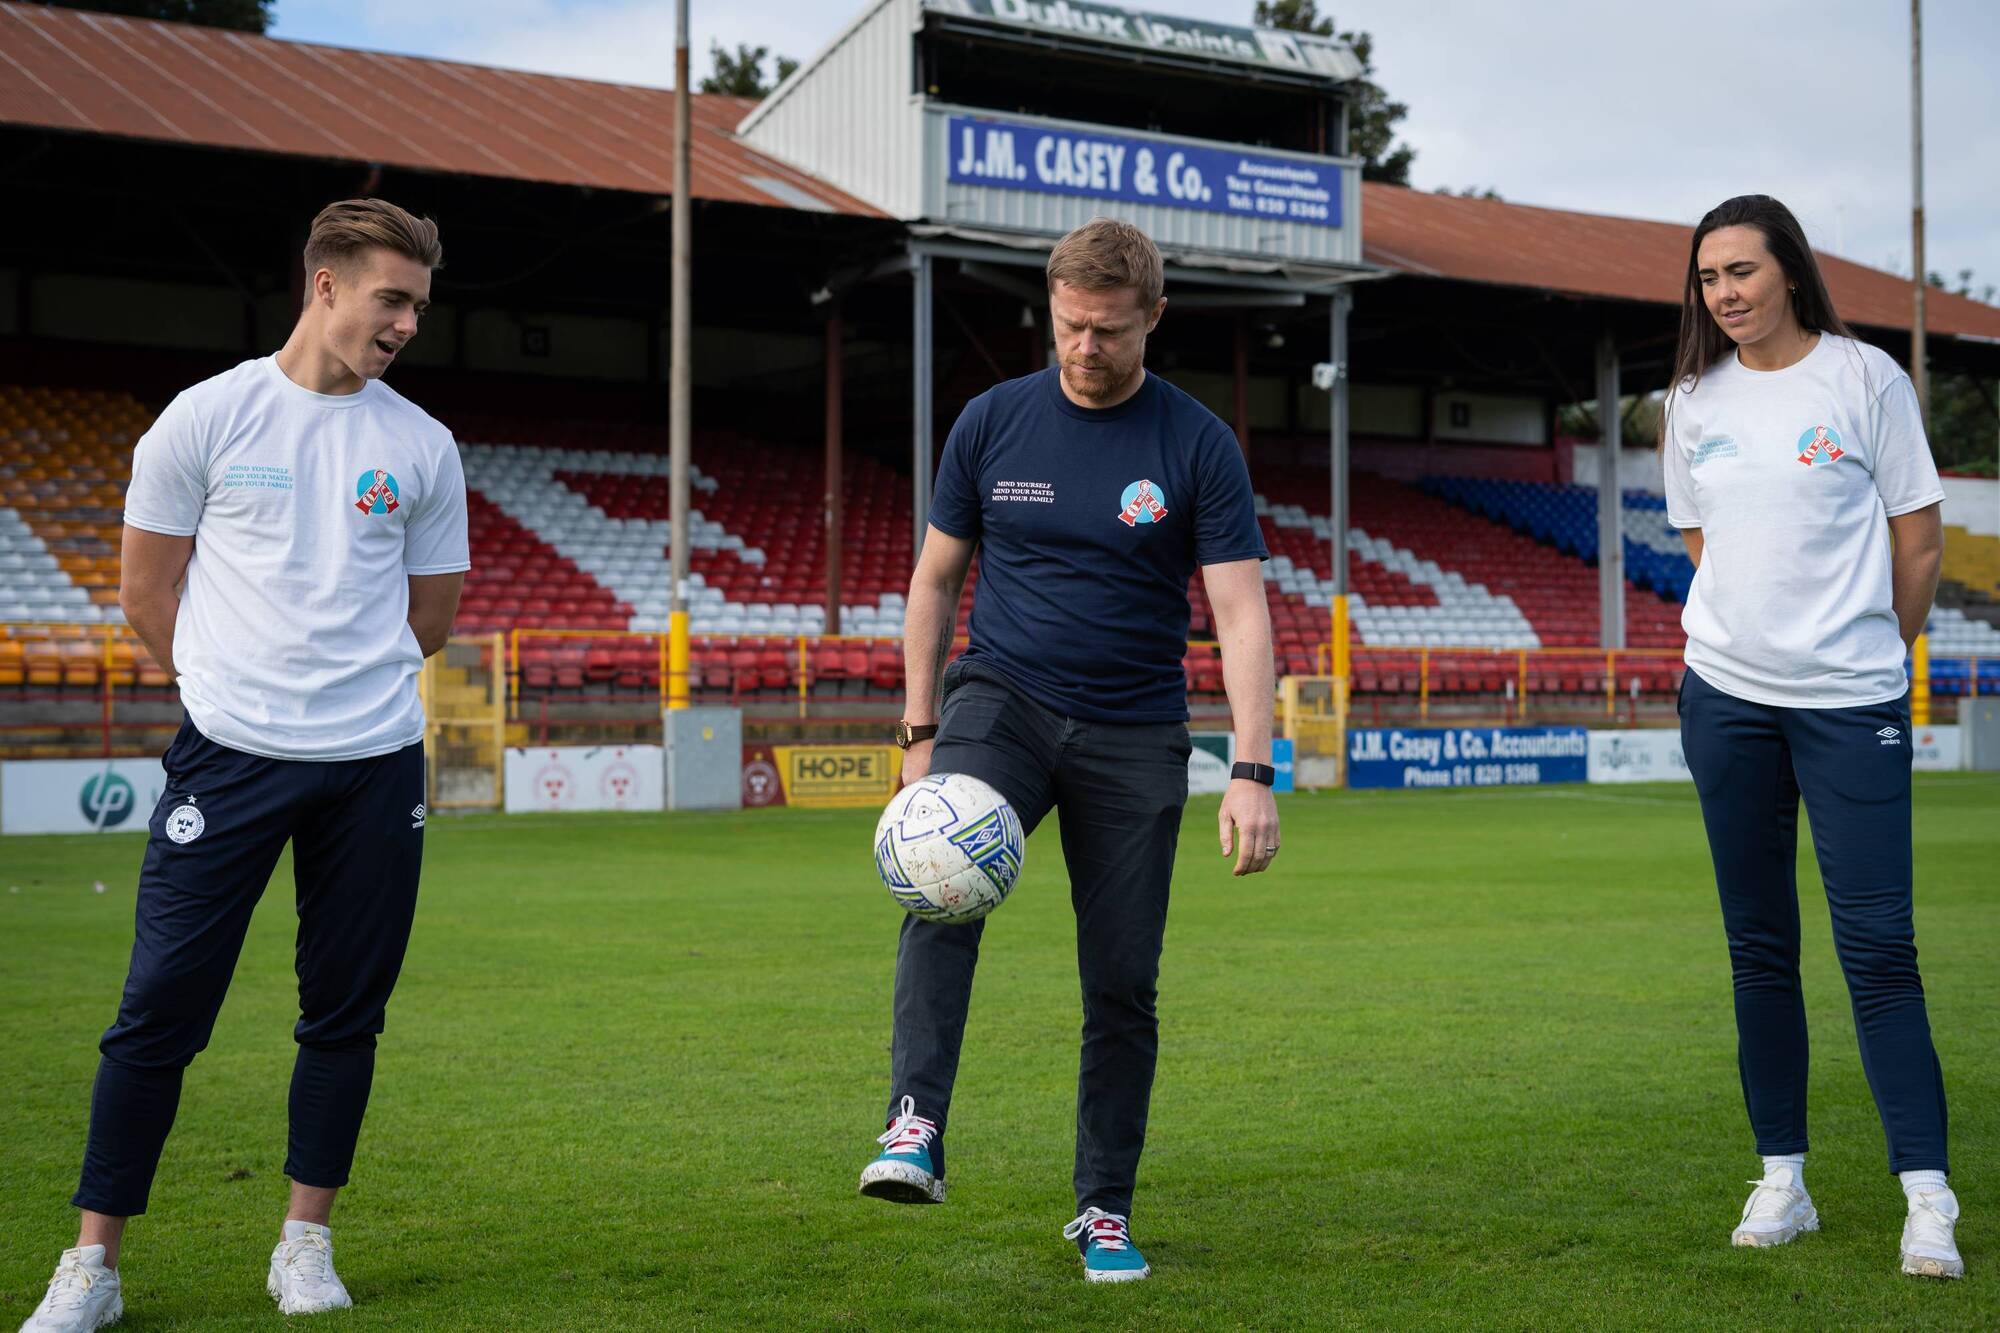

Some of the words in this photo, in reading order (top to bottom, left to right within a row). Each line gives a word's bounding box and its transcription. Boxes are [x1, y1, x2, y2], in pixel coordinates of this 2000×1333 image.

[988, 0, 1130, 38] Dulux
[1150, 22, 1257, 58] Paints
[958, 126, 1027, 181] J.M.
[1035, 135, 1127, 192] CASEY
[1133, 147, 1159, 196] &
[1166, 151, 1213, 203] Co.
[251, 465, 289, 474] YOURSELF
[268, 474, 293, 482] MATES
[267, 481, 293, 489] FAMILY
[1016, 481, 1052, 489] YOURSELF
[1350, 731, 1388, 761] J.M.
[1389, 730, 1441, 767] Casey
[1443, 730, 1459, 760] &
[1460, 730, 1488, 759] Co.
[1490, 729, 1585, 759] Accountants
[799, 757, 872, 779] HOPE
[1403, 766, 1451, 788] Phone
